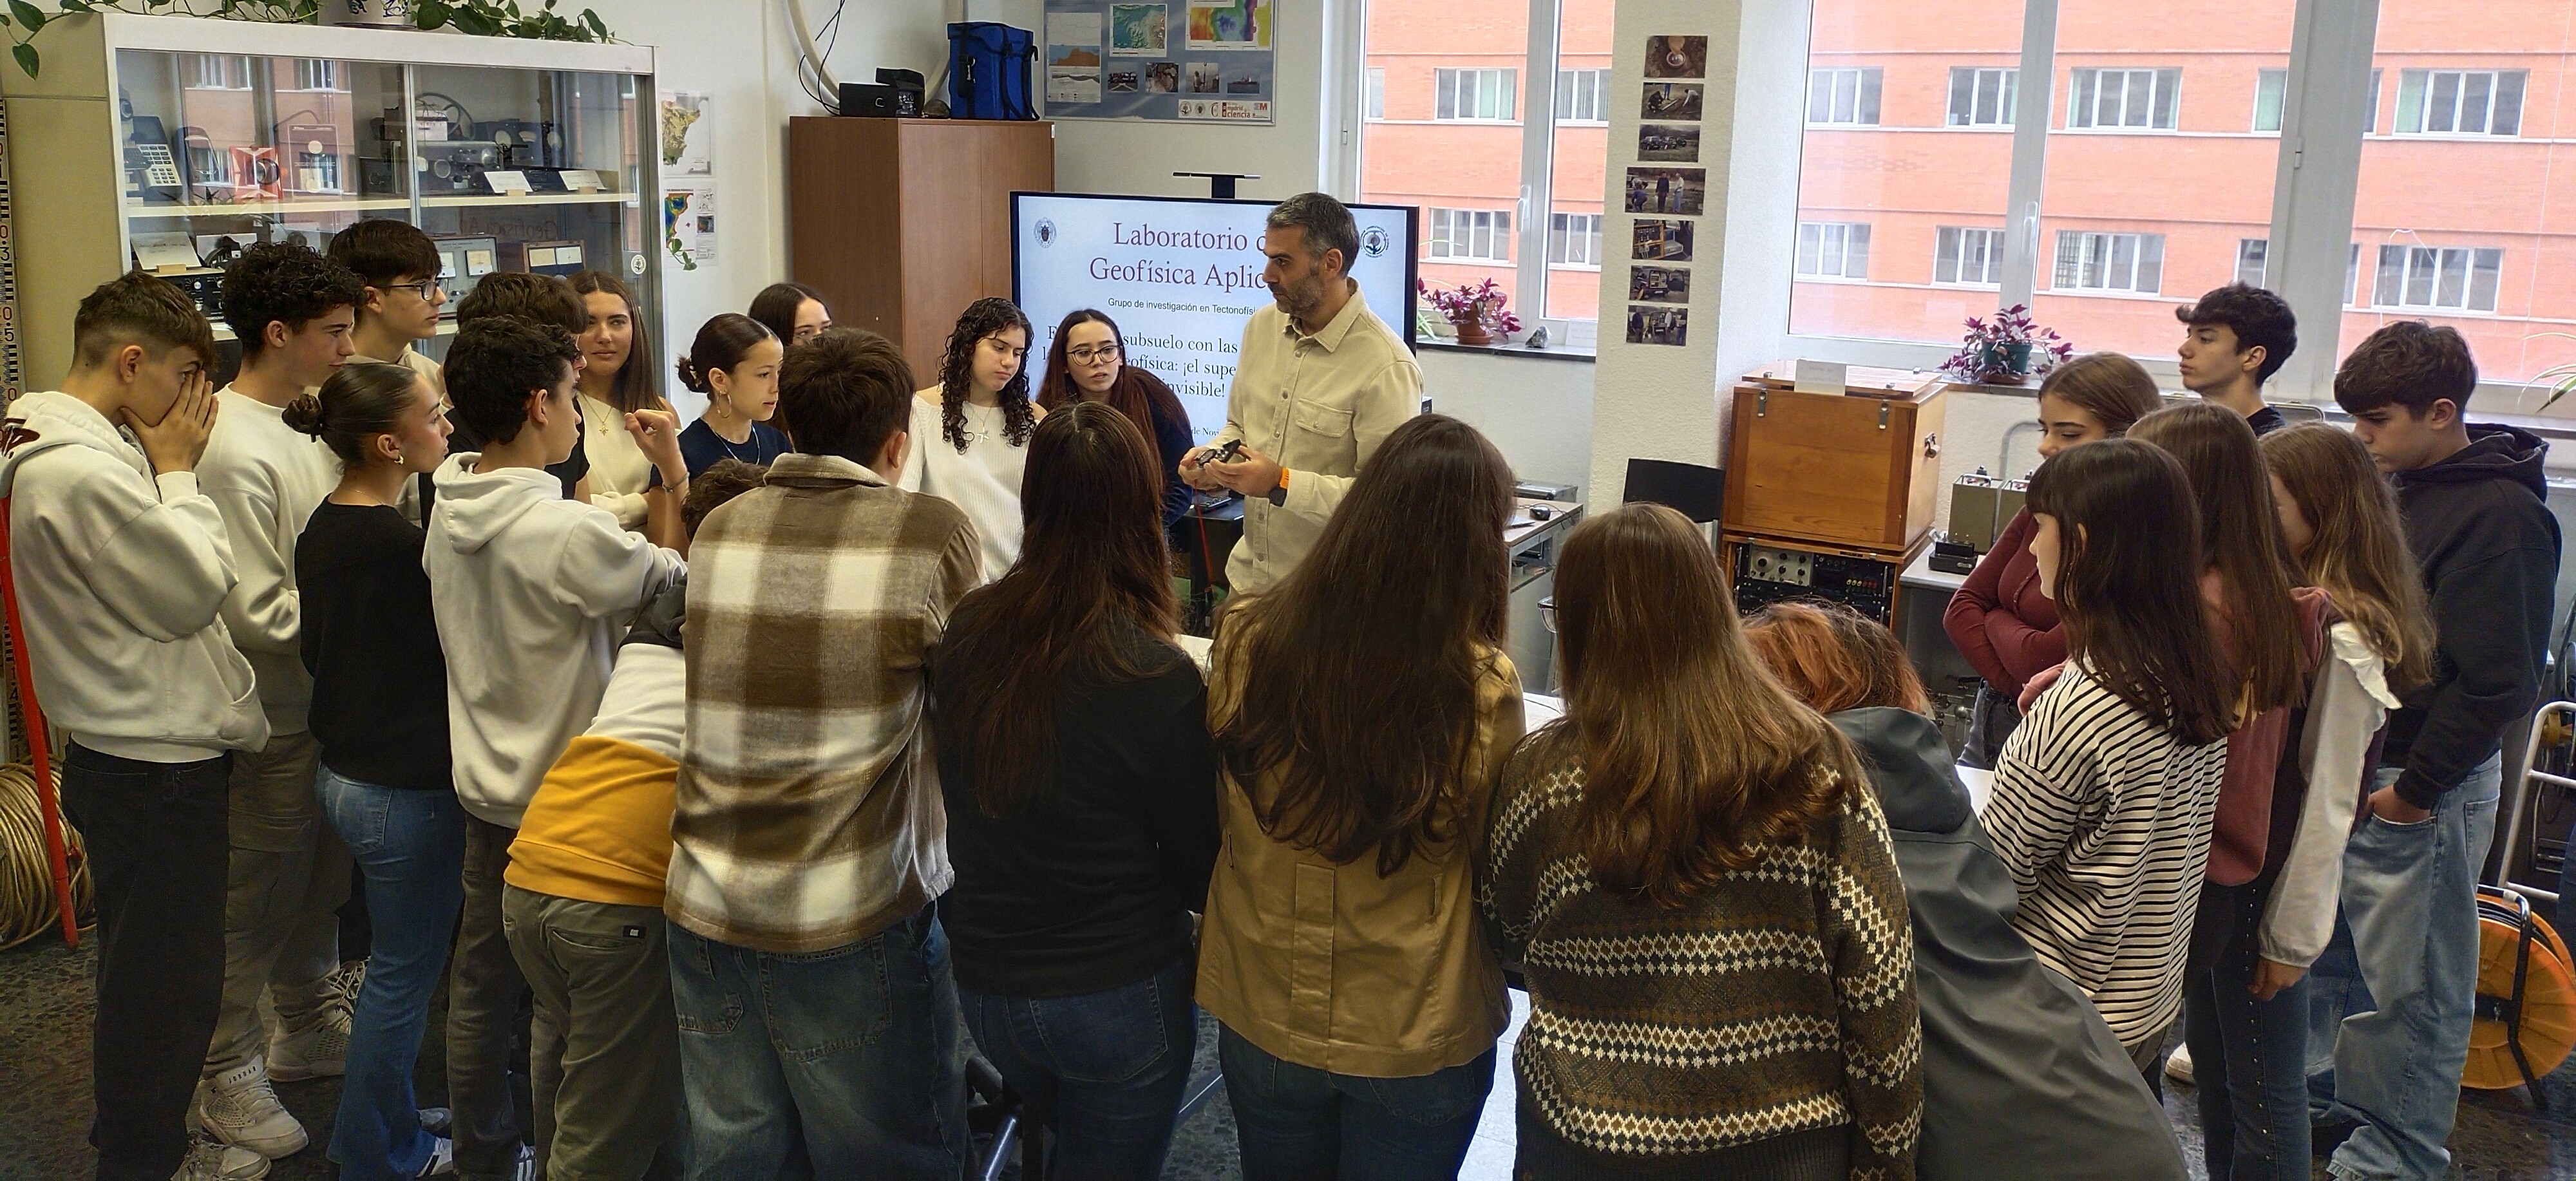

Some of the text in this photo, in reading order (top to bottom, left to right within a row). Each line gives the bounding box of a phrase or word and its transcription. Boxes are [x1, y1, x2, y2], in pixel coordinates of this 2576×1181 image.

[1113, 222, 1248, 251] Laboratorio
[1090, 257, 1266, 293] Geofísica Aplic
[1108, 298, 1132, 308] Grupo
[1134, 299, 1144, 308] de
[1146, 300, 1197, 312] investigación
[1212, 303, 1256, 316] Tectonofísi
[1123, 332, 1238, 354] subsuelo con las
[1183, 358, 1199, 377] ¡el
[1204, 363, 1237, 380] supe
[1202, 427, 1219, 437] Novi
